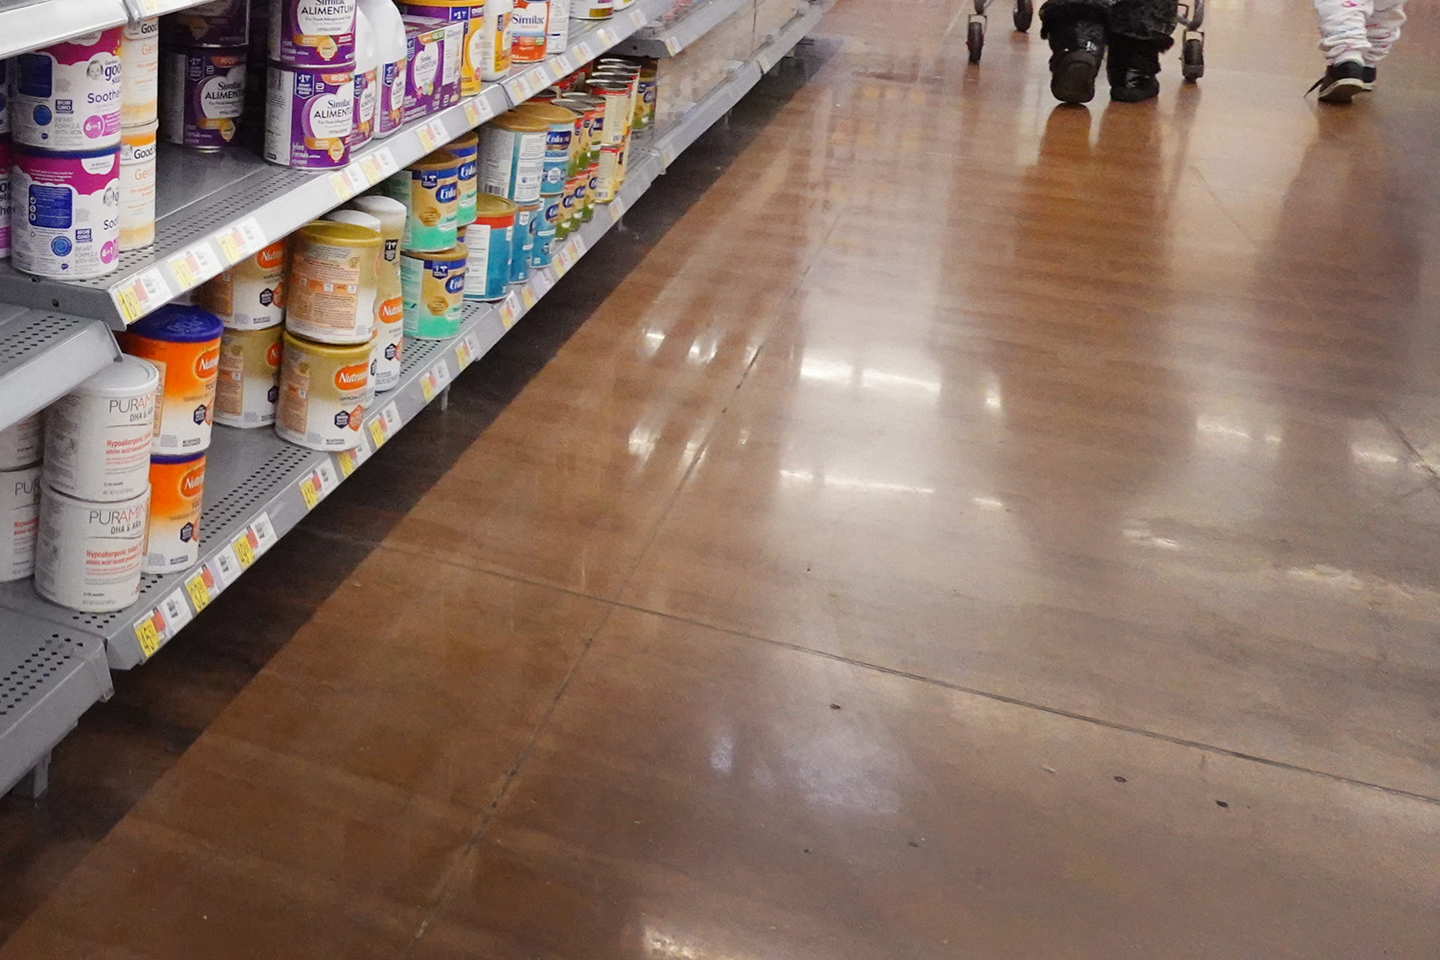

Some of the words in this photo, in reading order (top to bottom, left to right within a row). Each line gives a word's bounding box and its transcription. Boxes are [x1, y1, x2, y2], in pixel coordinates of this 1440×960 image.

[129, 410, 143, 422] DHA
[110, 526, 125, 535] DHA
[86, 549, 127, 559] Hypoallergenic
